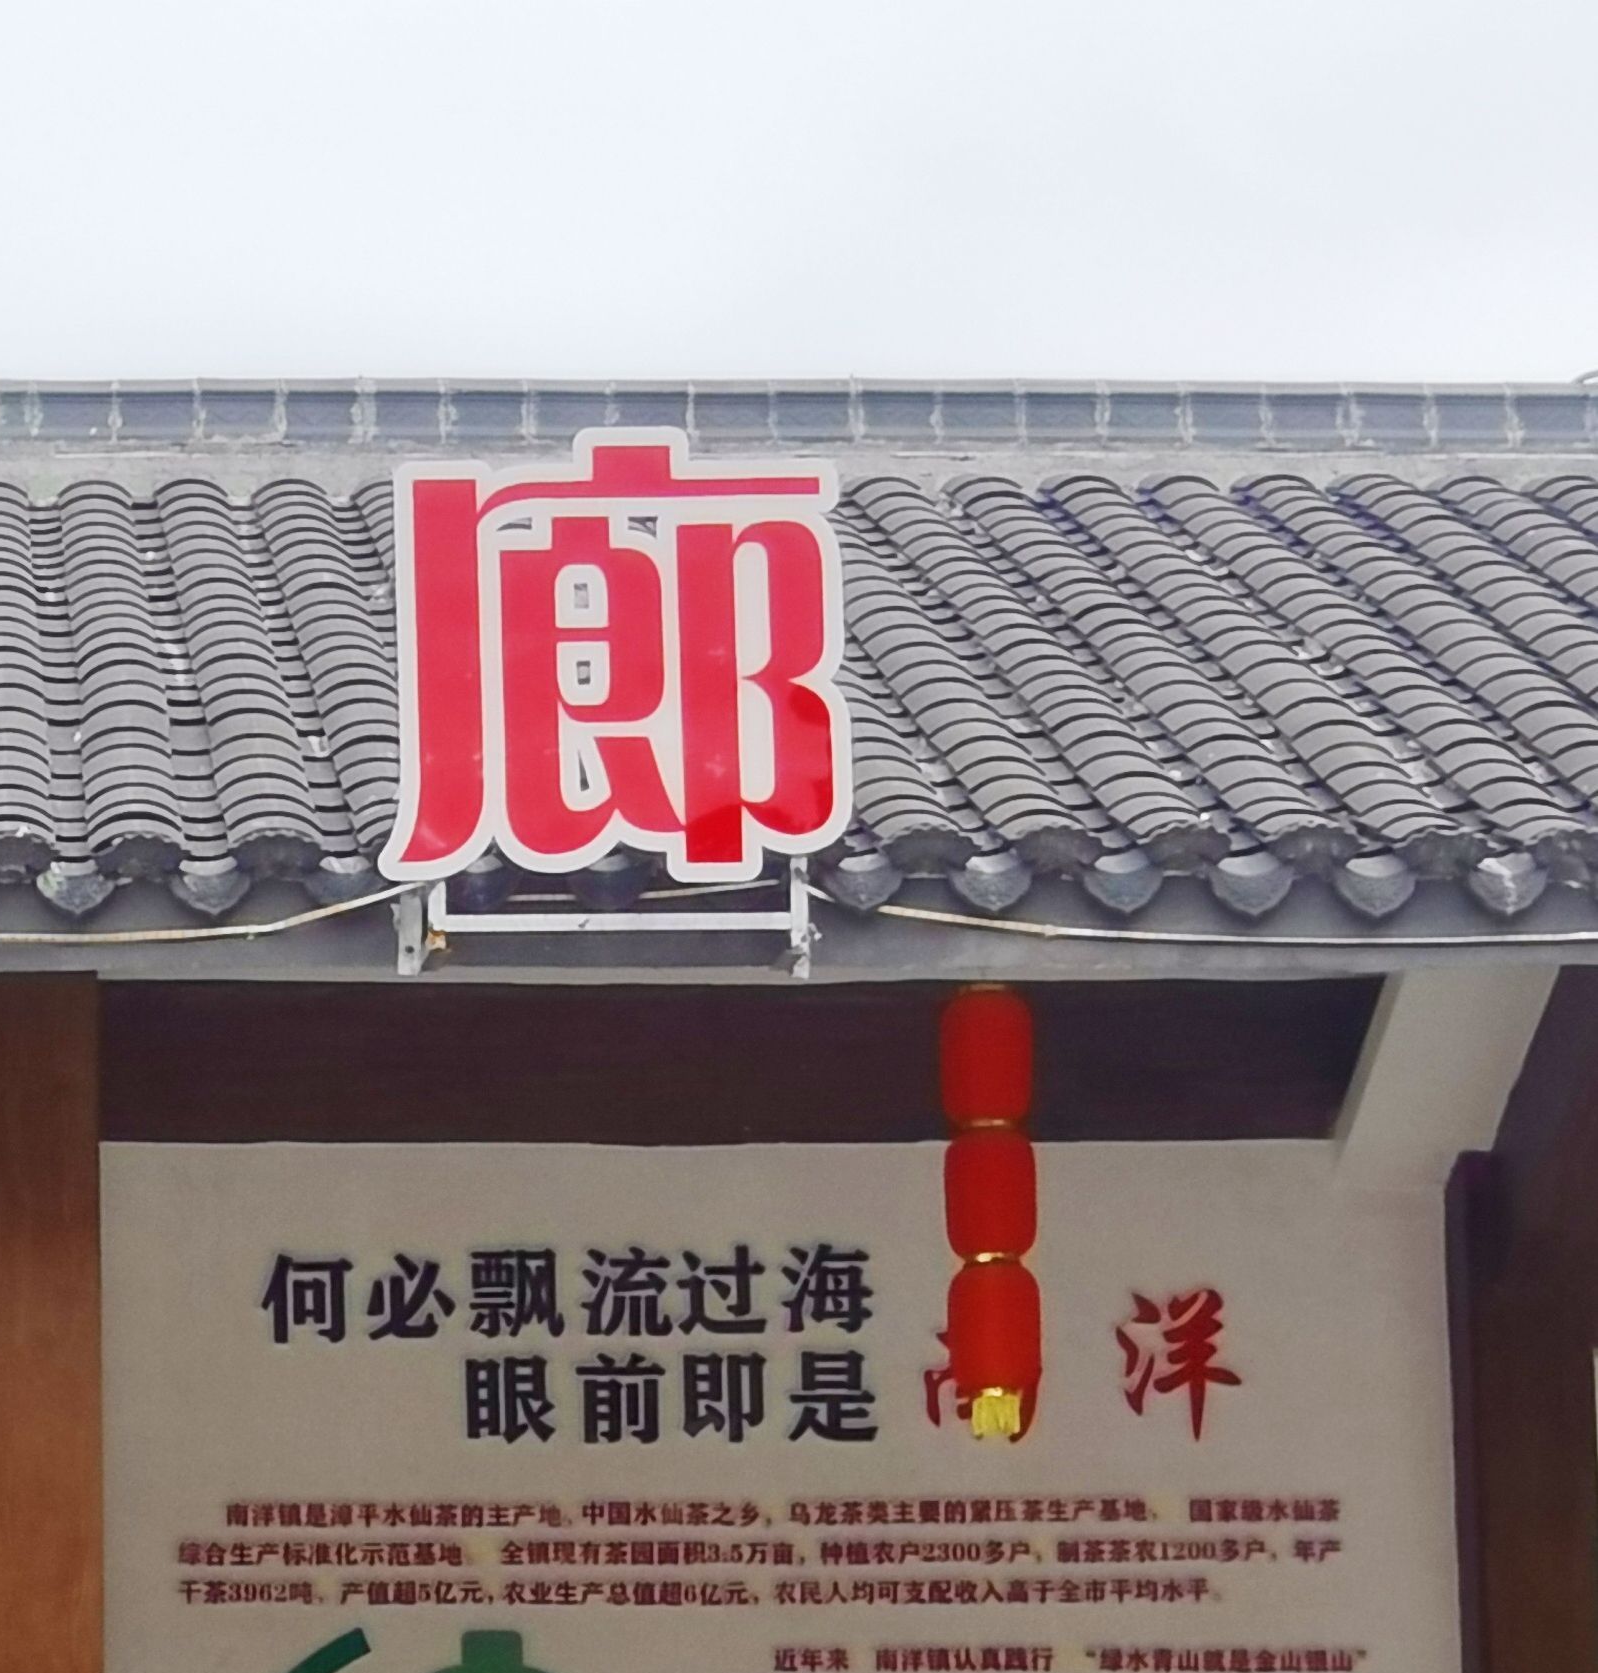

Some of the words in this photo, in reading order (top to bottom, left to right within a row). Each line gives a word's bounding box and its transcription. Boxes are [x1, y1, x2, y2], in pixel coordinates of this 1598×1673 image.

[260, 1245, 875, 1344] 何必飘流过海
[464, 1350, 880, 1445] 眼前即是
